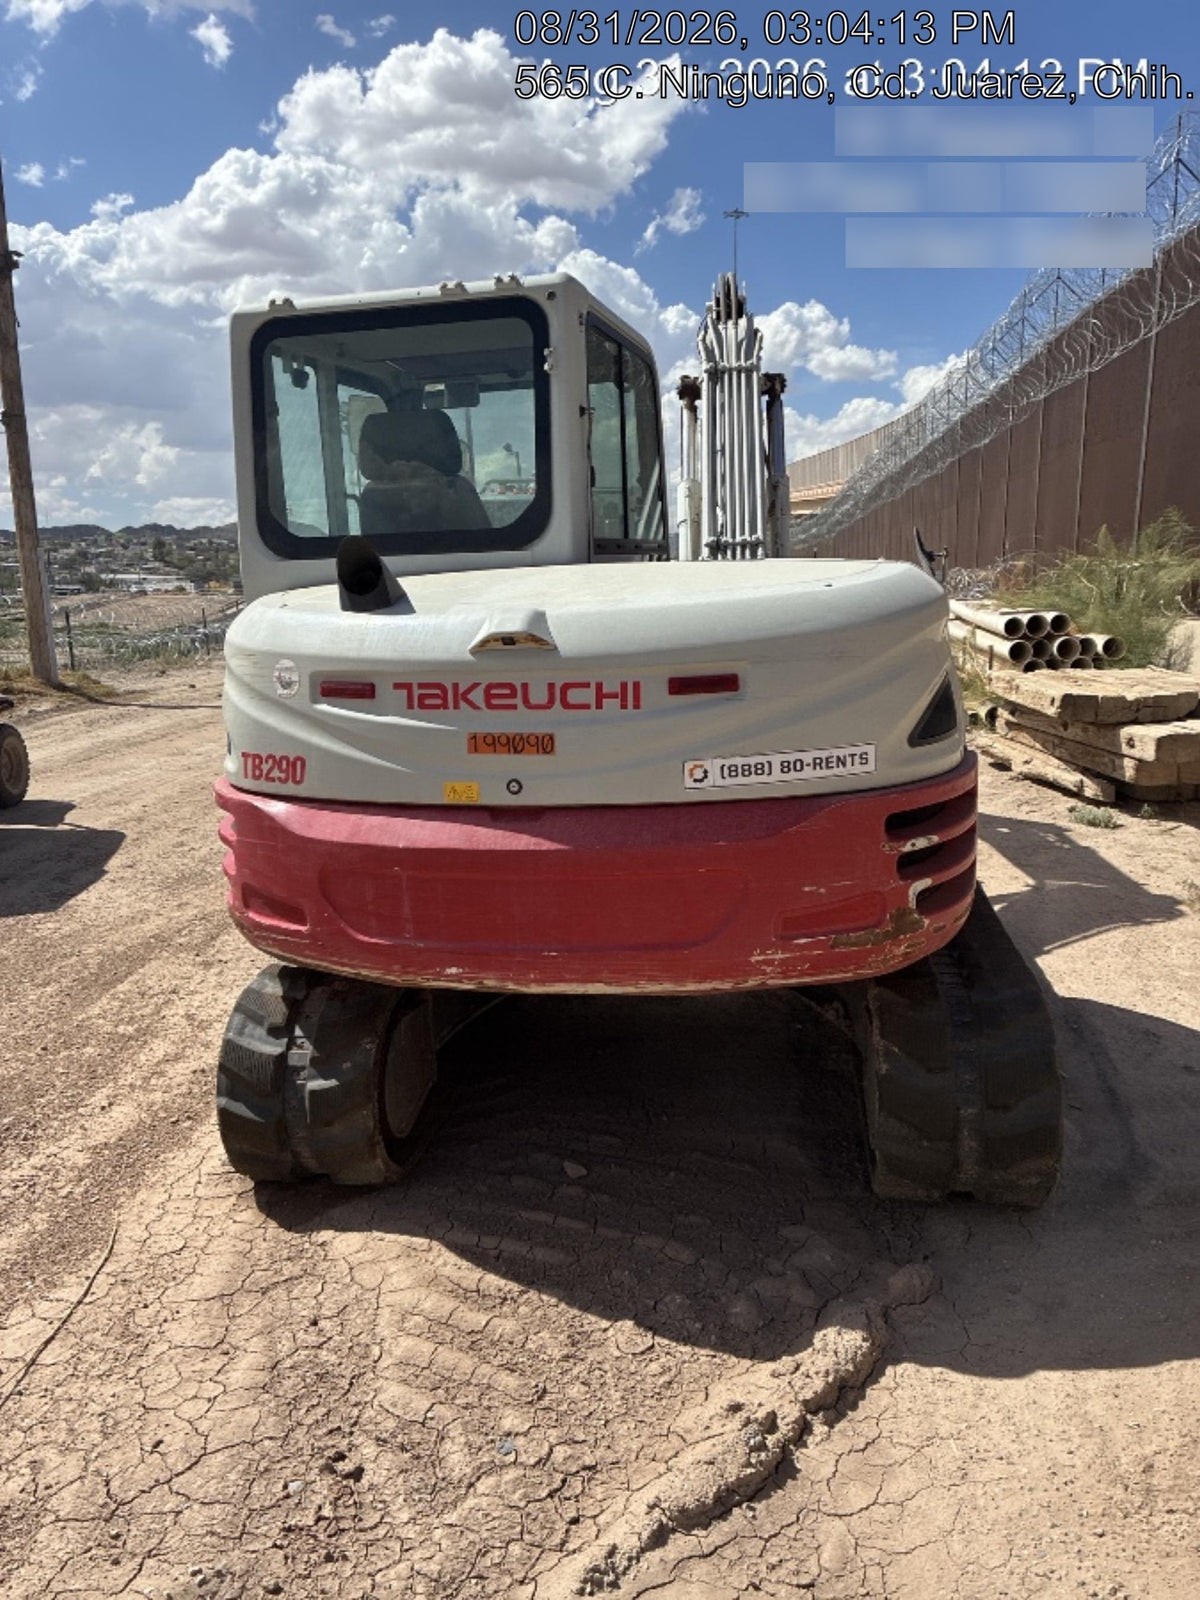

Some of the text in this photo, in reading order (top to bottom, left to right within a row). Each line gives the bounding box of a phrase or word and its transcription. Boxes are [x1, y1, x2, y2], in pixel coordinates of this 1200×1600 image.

[469, 732, 554, 755] 199090
[241, 752, 307, 786] TB290
[720, 751, 869, 780] (888) 80-RENTS
